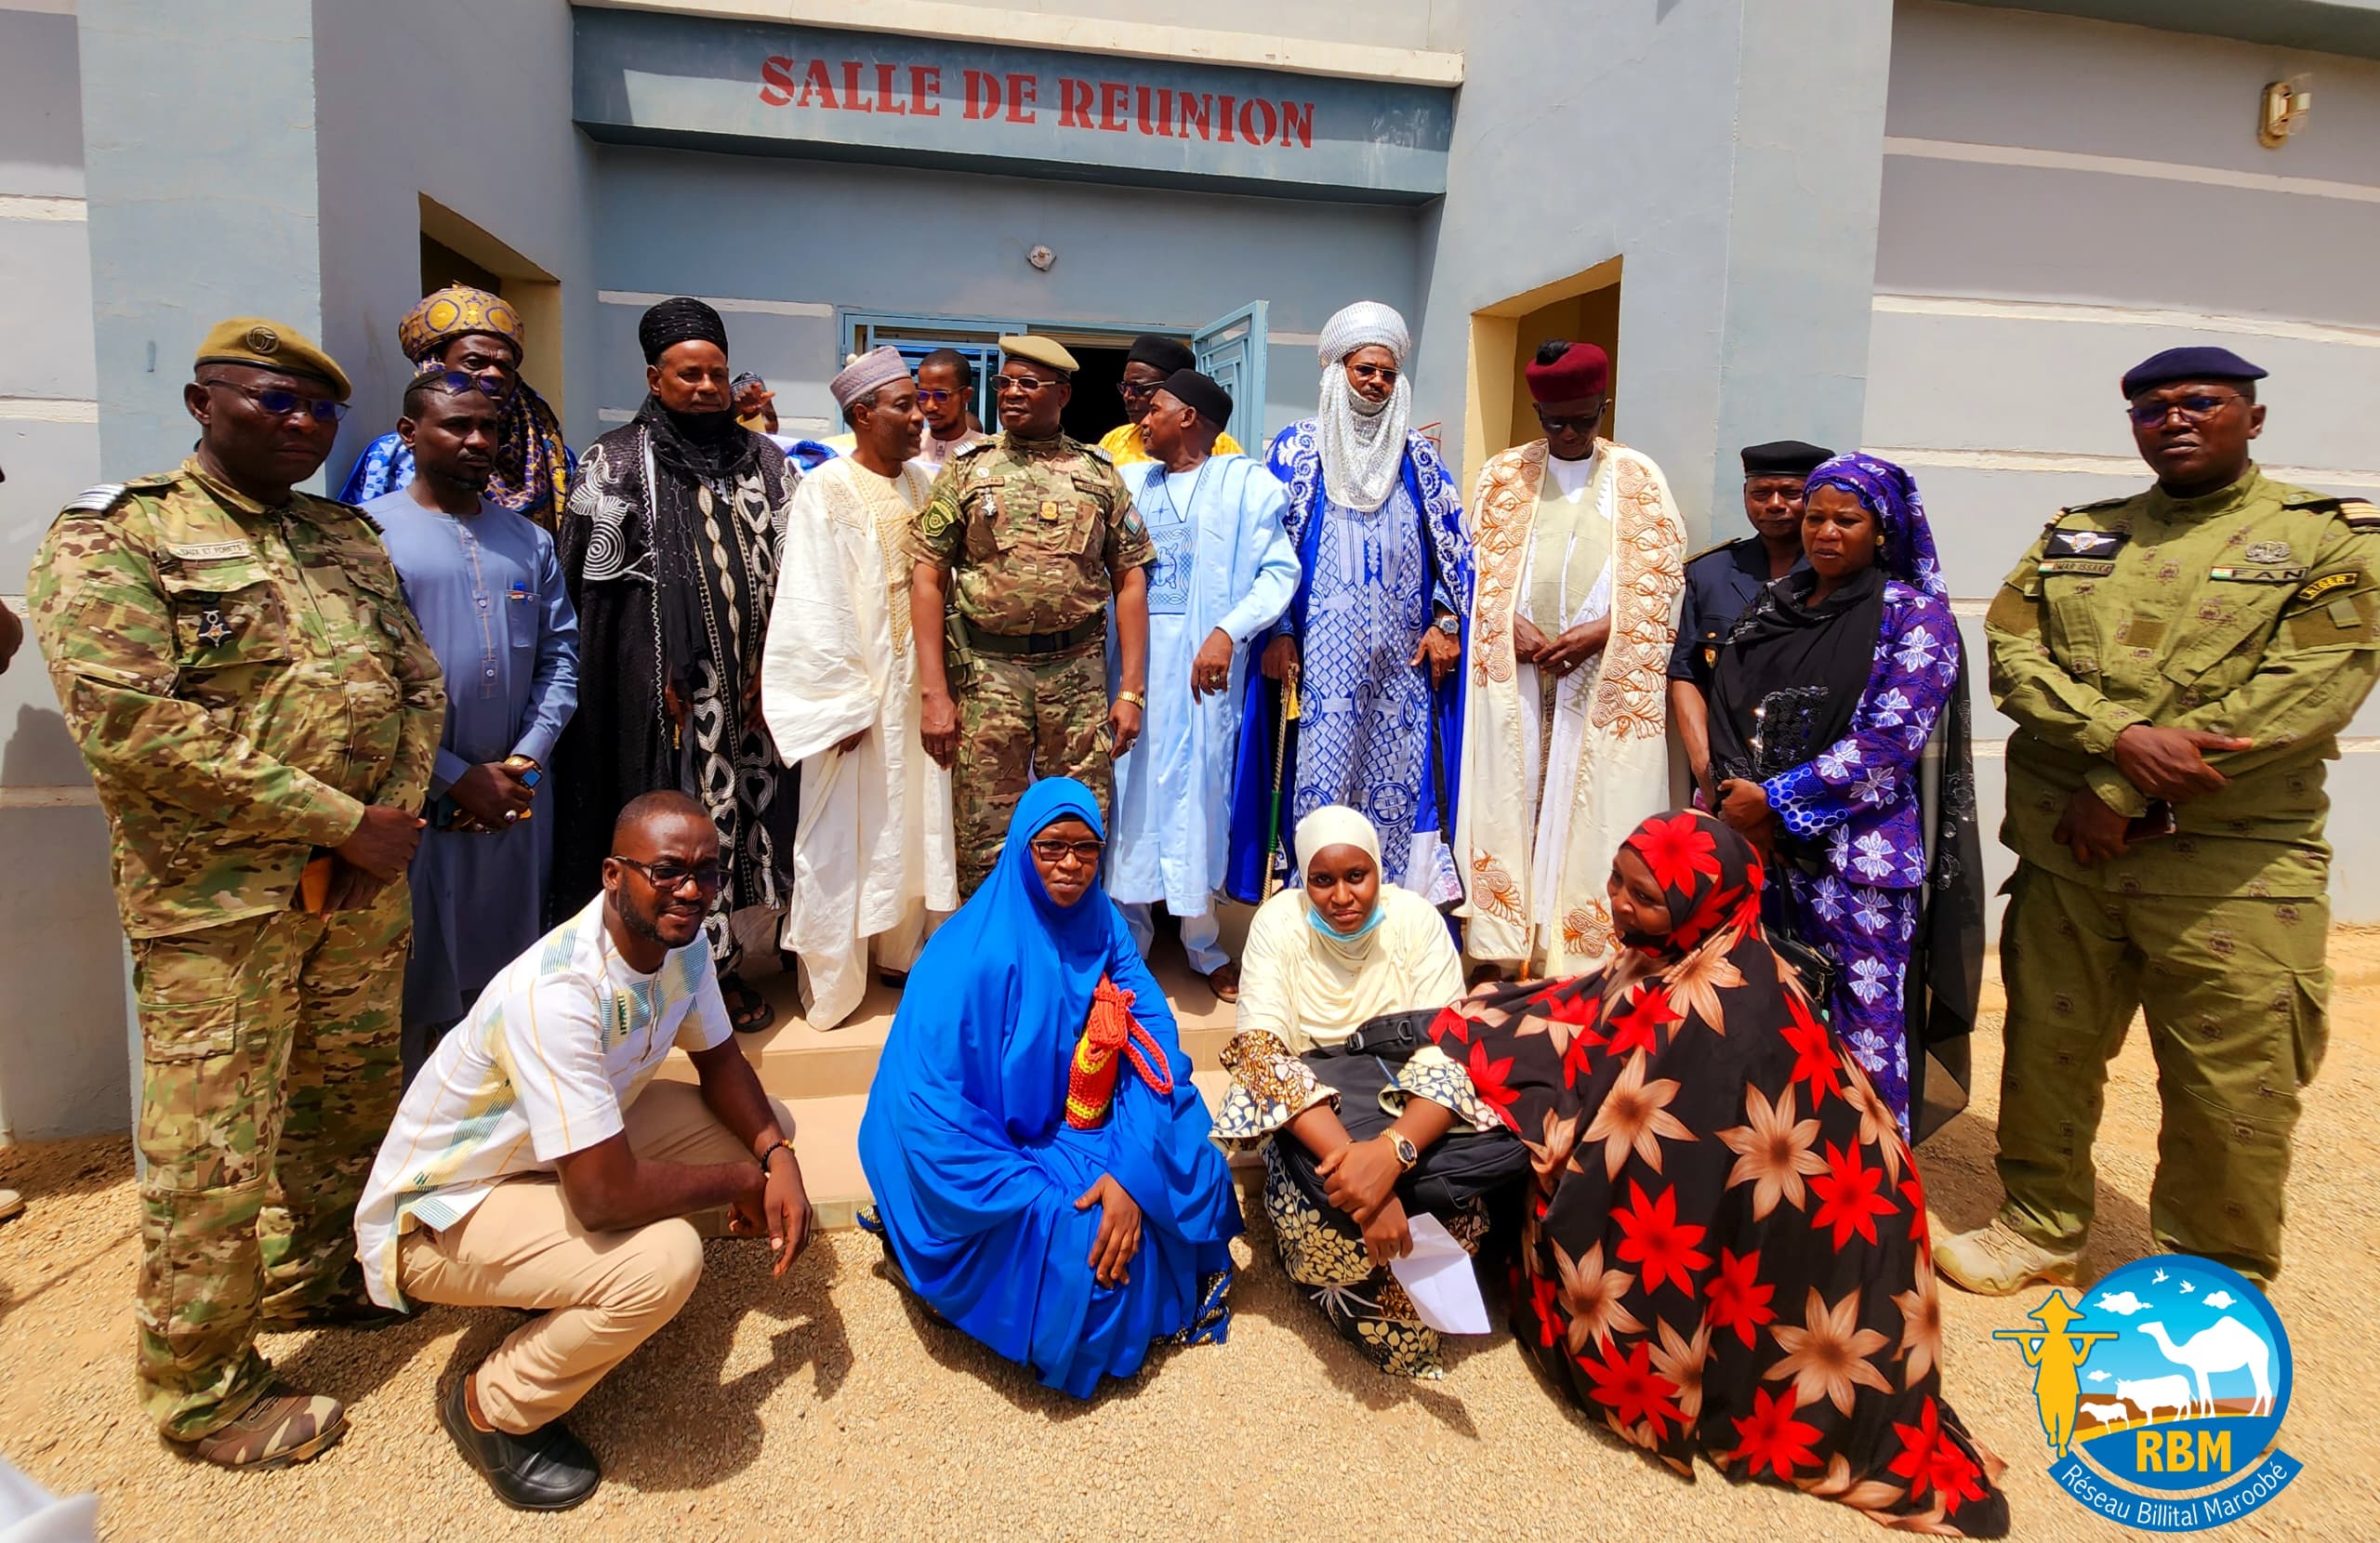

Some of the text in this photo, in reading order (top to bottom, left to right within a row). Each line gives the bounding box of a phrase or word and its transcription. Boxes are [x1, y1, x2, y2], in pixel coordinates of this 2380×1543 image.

[759, 56, 1315, 149] SALLE DE REUNION
[2232, 569, 2304, 580] FAN
[2306, 574, 2347, 596] NIGER
